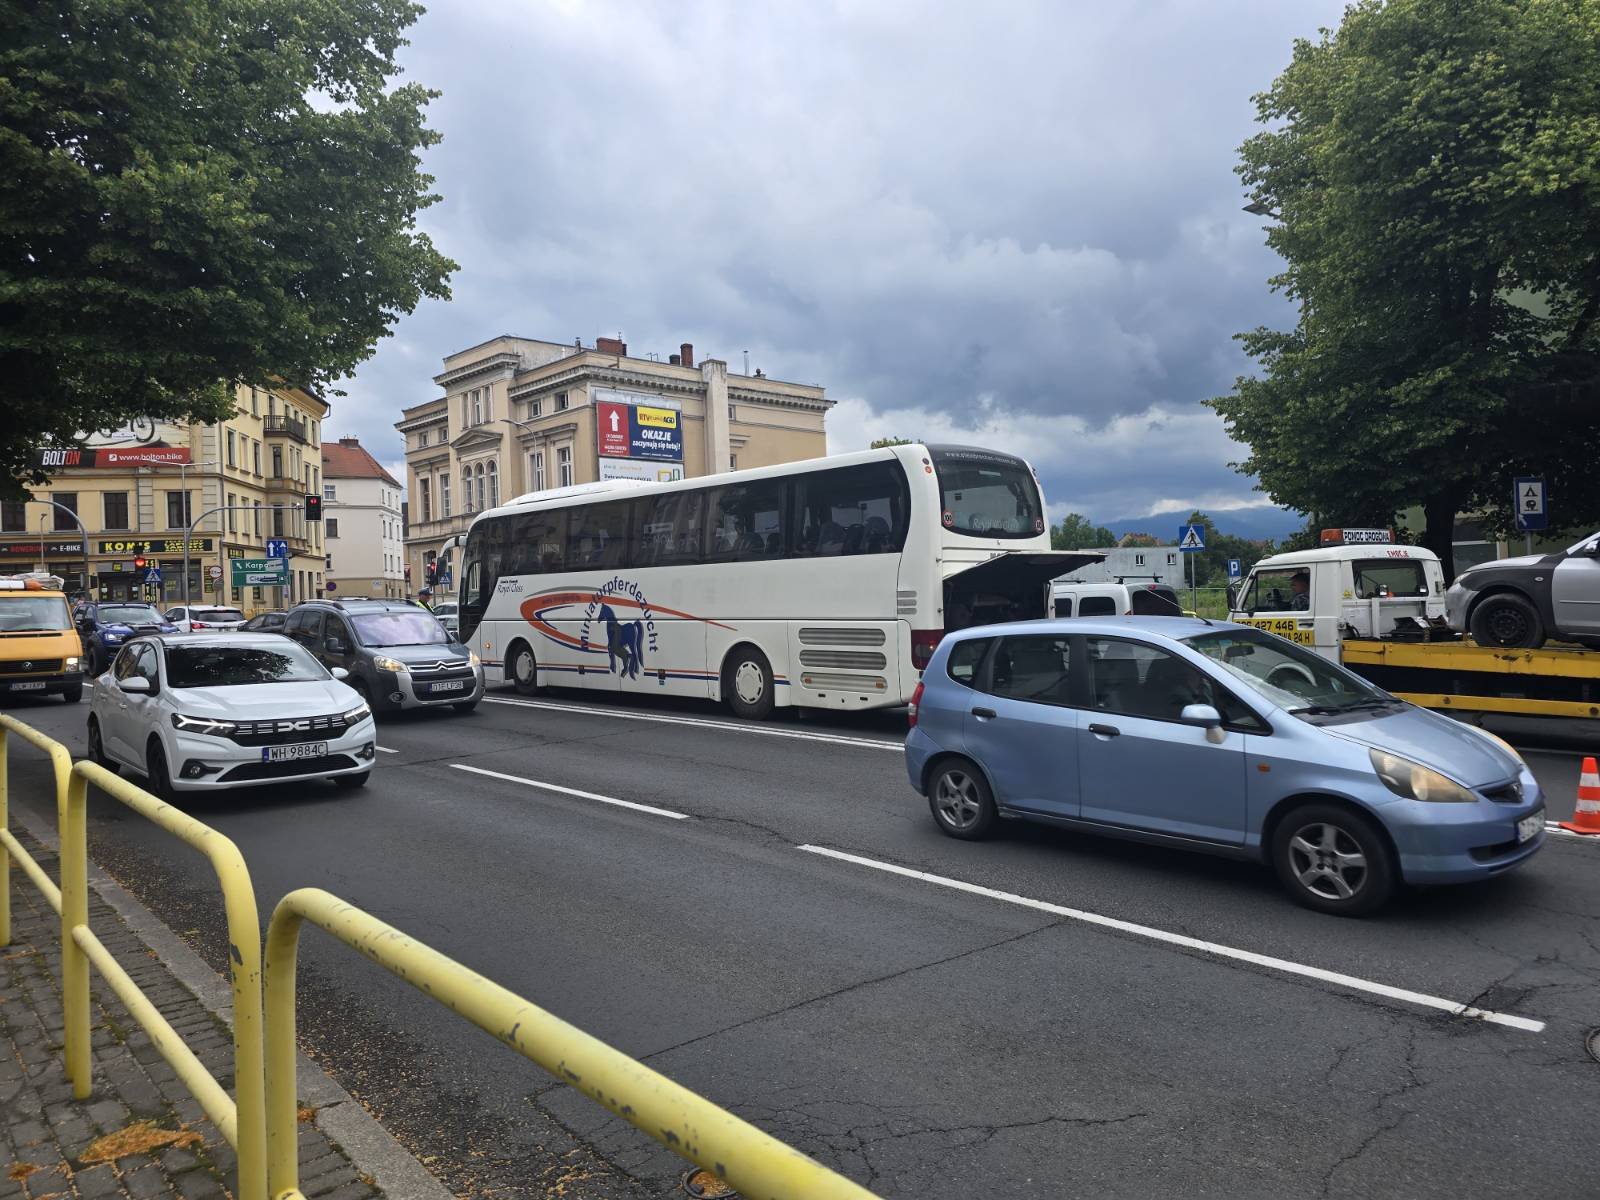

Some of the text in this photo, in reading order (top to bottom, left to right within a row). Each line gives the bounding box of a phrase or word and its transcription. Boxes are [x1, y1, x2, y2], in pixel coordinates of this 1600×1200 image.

[642, 429, 672, 441] OKAZJE
[42, 451, 80, 466] BOLTON
[120, 453, 183, 461] www.bolton.bike
[1344, 532, 1389, 542] POMOC DROGOWA
[245, 562, 268, 570] Karpa
[580, 576, 659, 652] Miniaturpferdezucht
[1276, 621, 1294, 630] 446
[271, 744, 324, 760] WH 9884C
